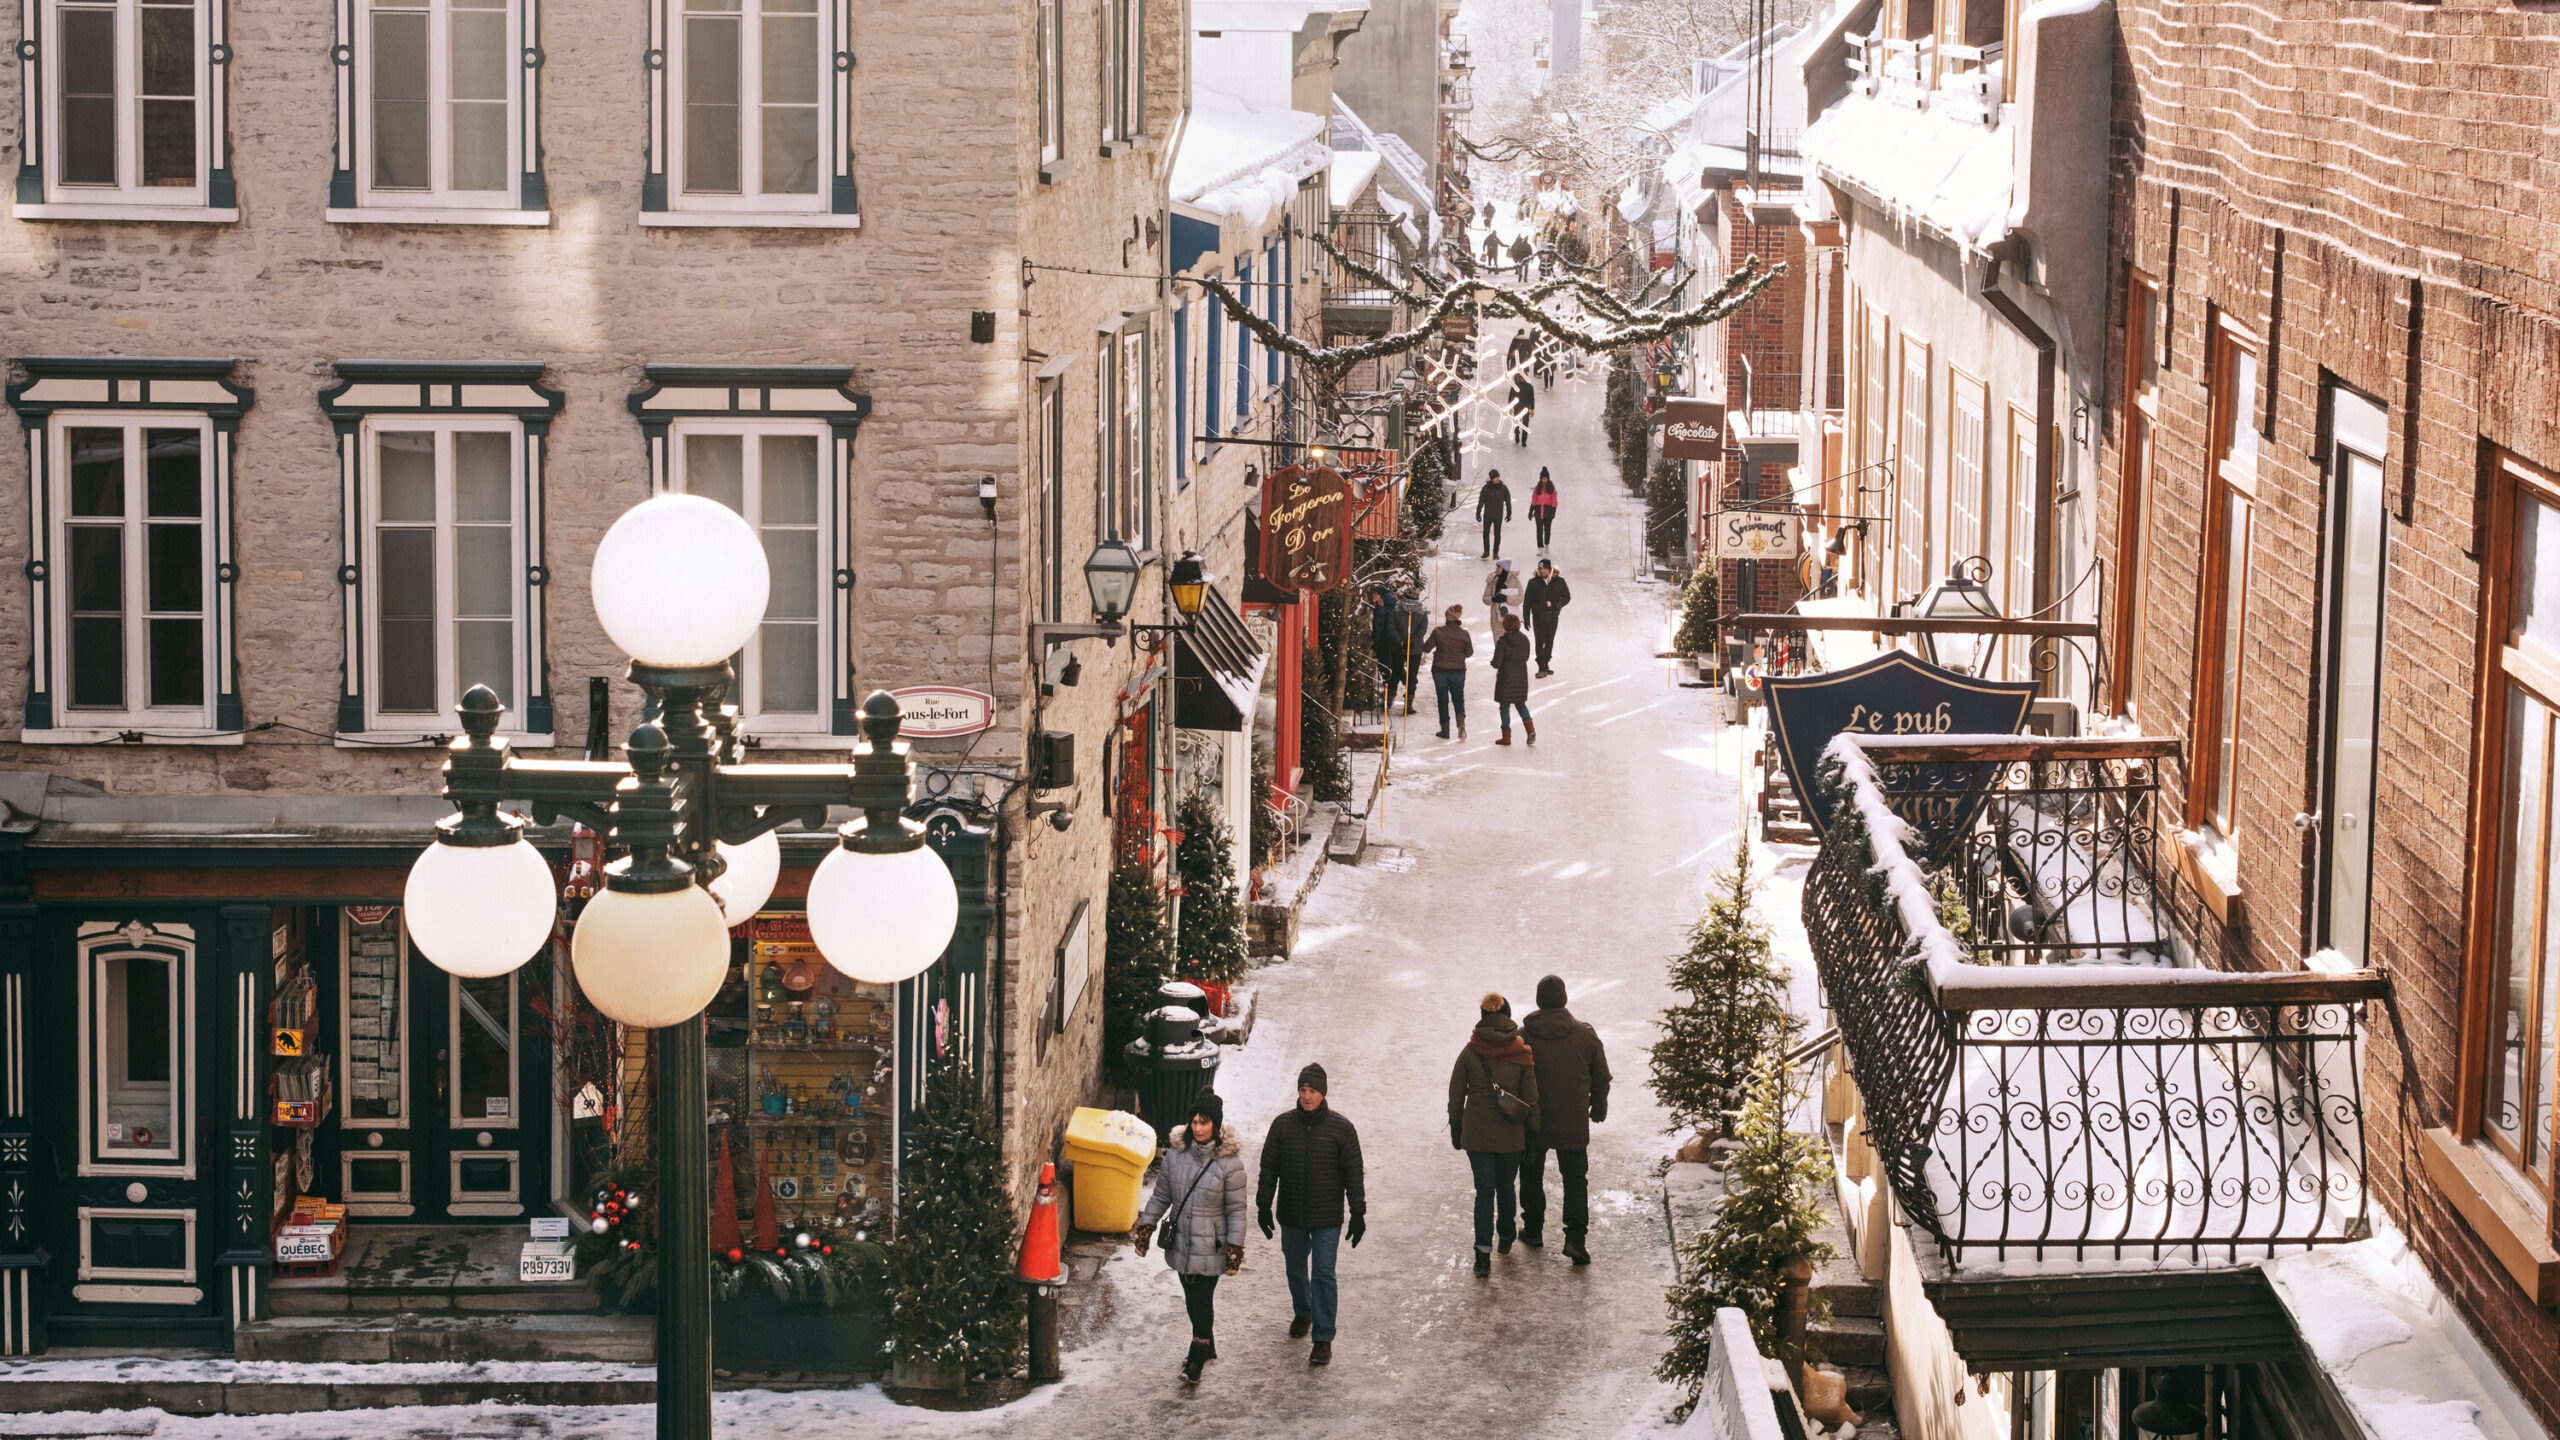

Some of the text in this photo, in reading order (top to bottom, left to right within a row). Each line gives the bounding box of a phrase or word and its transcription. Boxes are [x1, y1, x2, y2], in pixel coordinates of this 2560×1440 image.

[1667, 422, 1719, 441] Chocolato
[1288, 482, 1311, 500] Le
[1269, 491, 1344, 534] Forgeron
[903, 707, 969, 720] ous-le-Fort
[1842, 702, 1952, 736] Le pub
[280, 1243, 326, 1255] QUÉBEC
